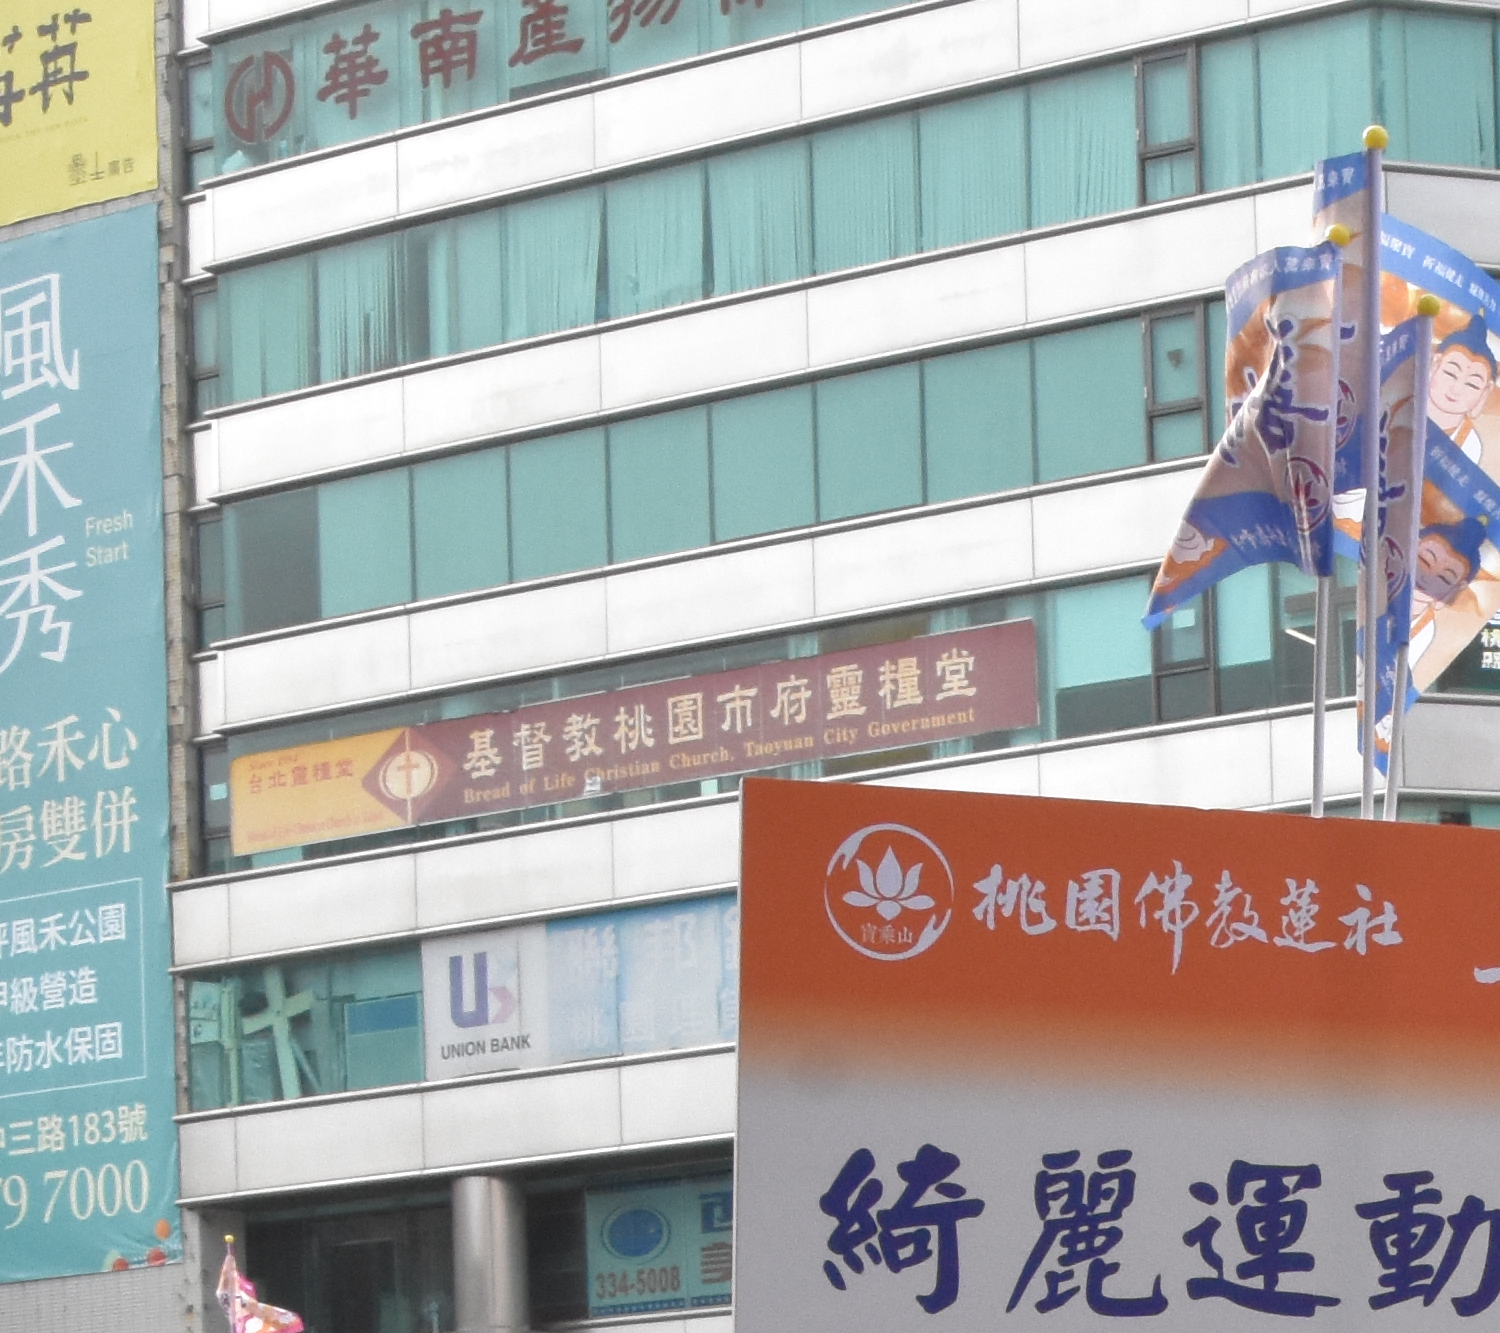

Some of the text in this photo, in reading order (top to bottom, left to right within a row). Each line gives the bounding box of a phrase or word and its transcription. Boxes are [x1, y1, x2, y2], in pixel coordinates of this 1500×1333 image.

[84, 509, 134, 539] Fresh
[85, 540, 130, 567] Start
[463, 648, 977, 779] 基督教桃園市府靈糧堂
[464, 783, 511, 804] Bread
[520, 777, 536, 795] of
[544, 774, 576, 792] Life
[584, 758, 660, 786] Christian
[744, 733, 814, 759] Taoyuan
[824, 727, 859, 746] City
[868, 707, 976, 738] Government
[972, 860, 1402, 976] 桃園佛教蓮社
[441, 1034, 531, 1060] UNION BANK
[42, 1159, 150, 1226] 7000
